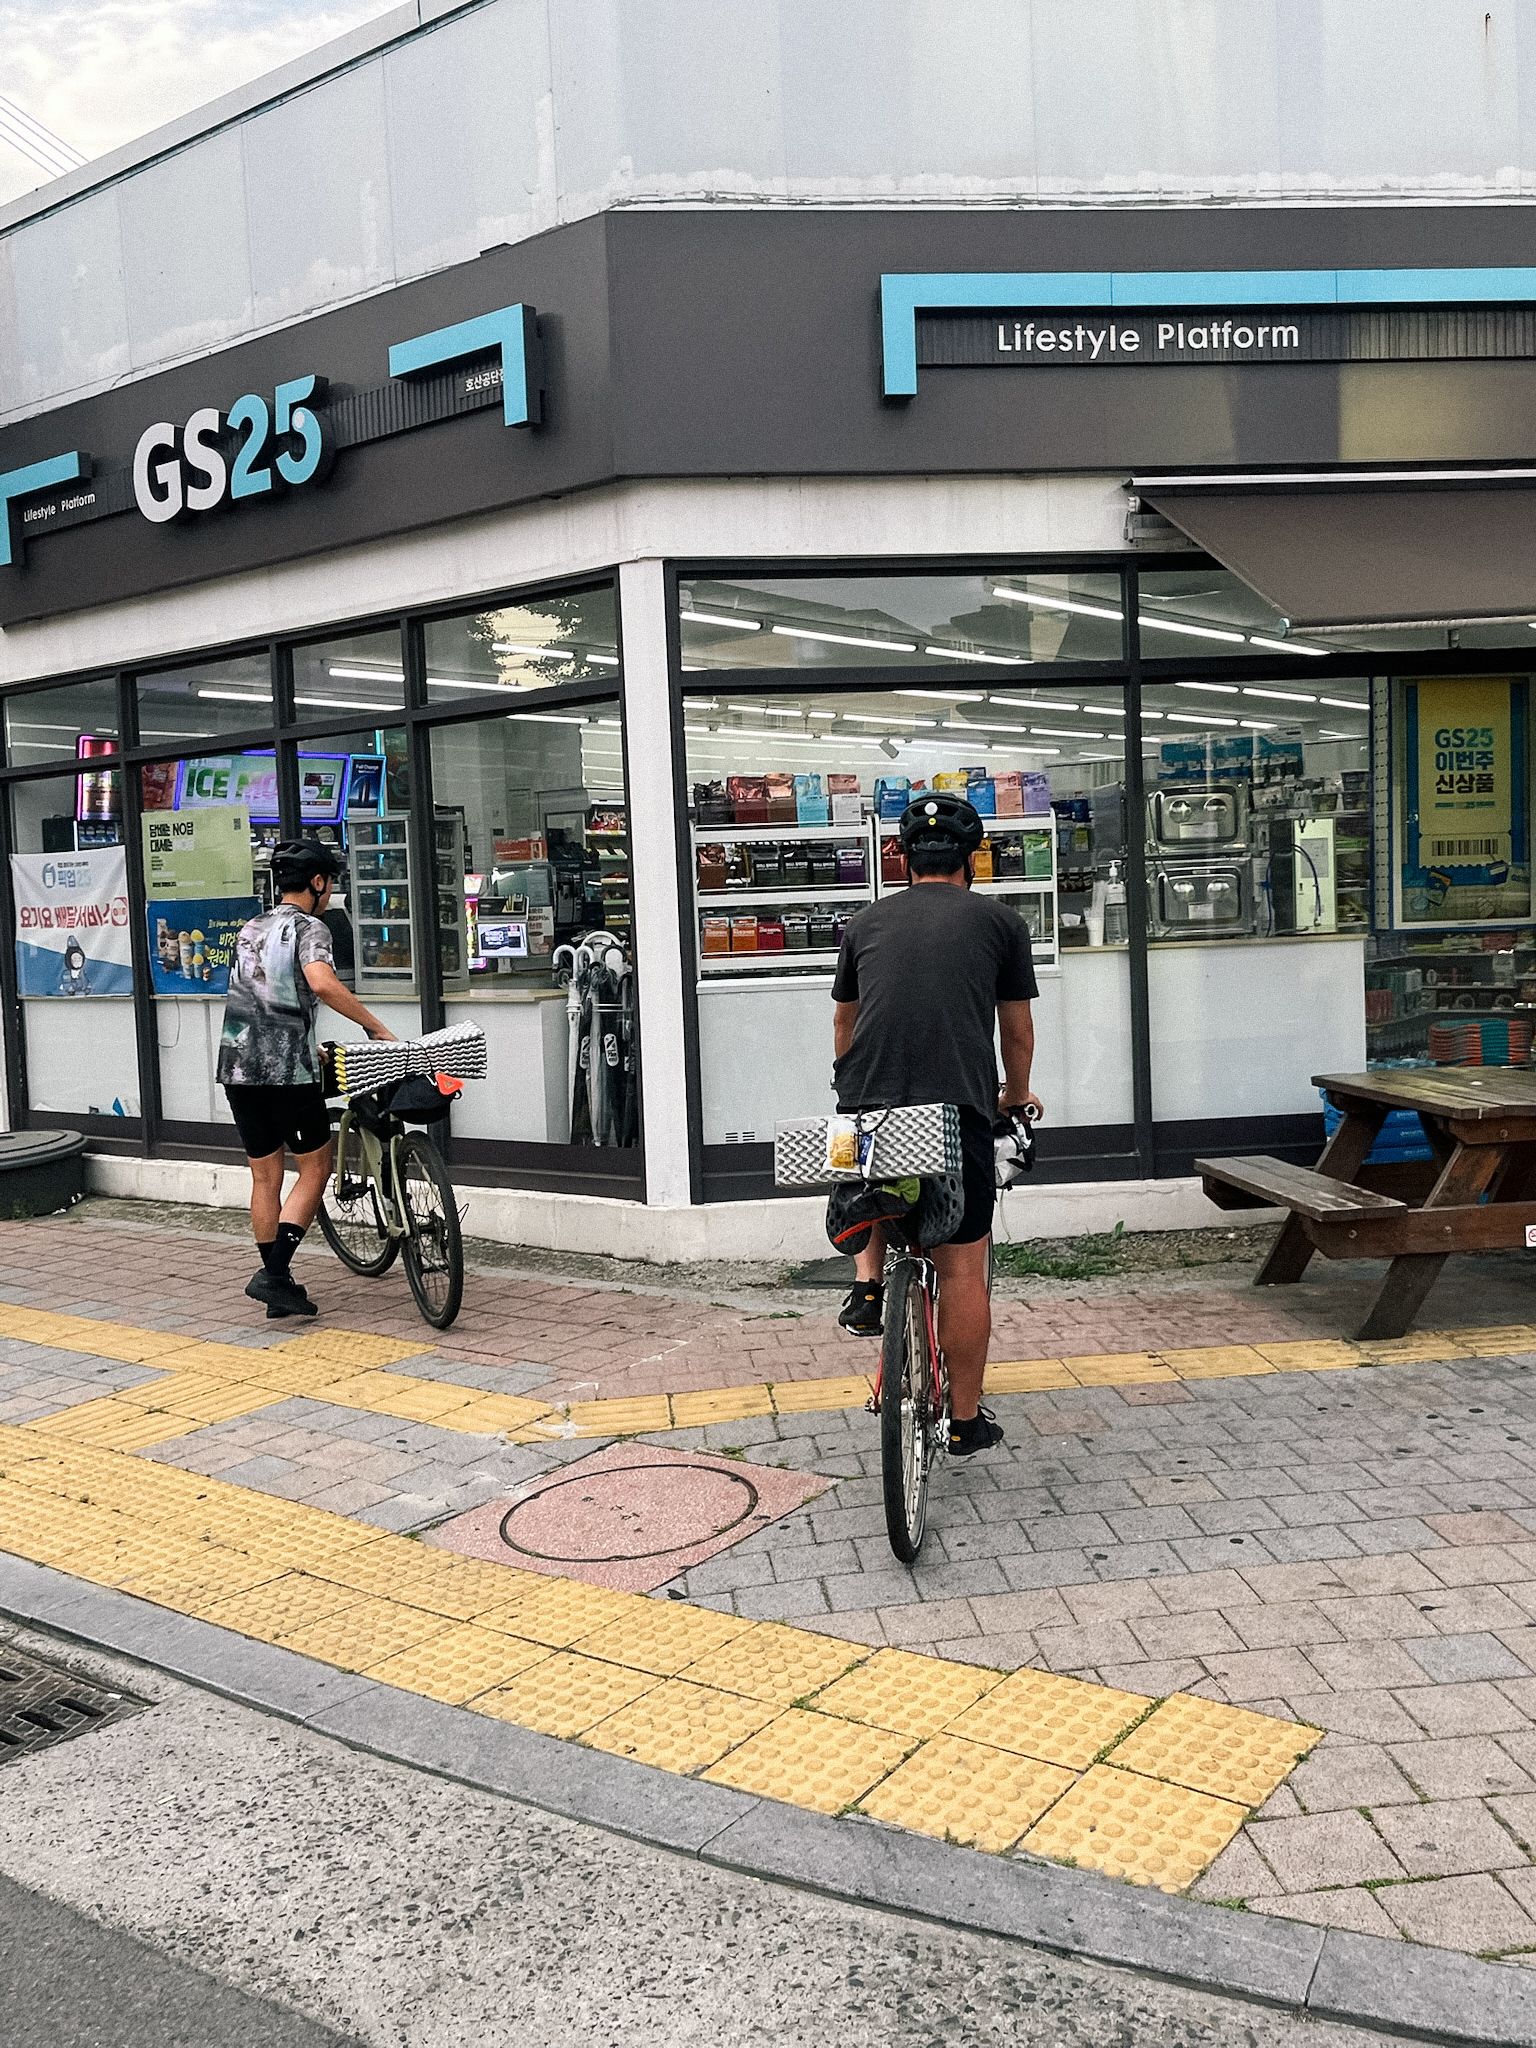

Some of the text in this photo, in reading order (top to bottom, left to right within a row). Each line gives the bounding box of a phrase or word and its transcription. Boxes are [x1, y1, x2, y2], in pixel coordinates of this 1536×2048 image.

[998, 320, 1299, 359] Lifestyle Platform
[133, 374, 322, 523] GS25
[24, 492, 96, 523] Lifestyle Platform
[1434, 727, 1494, 749] GS25
[1435, 751, 1494, 771] 이번주
[186, 768, 231, 798] ICE
[1435, 773, 1494, 794] 신상품
[20, 906, 53, 928] 요기요
